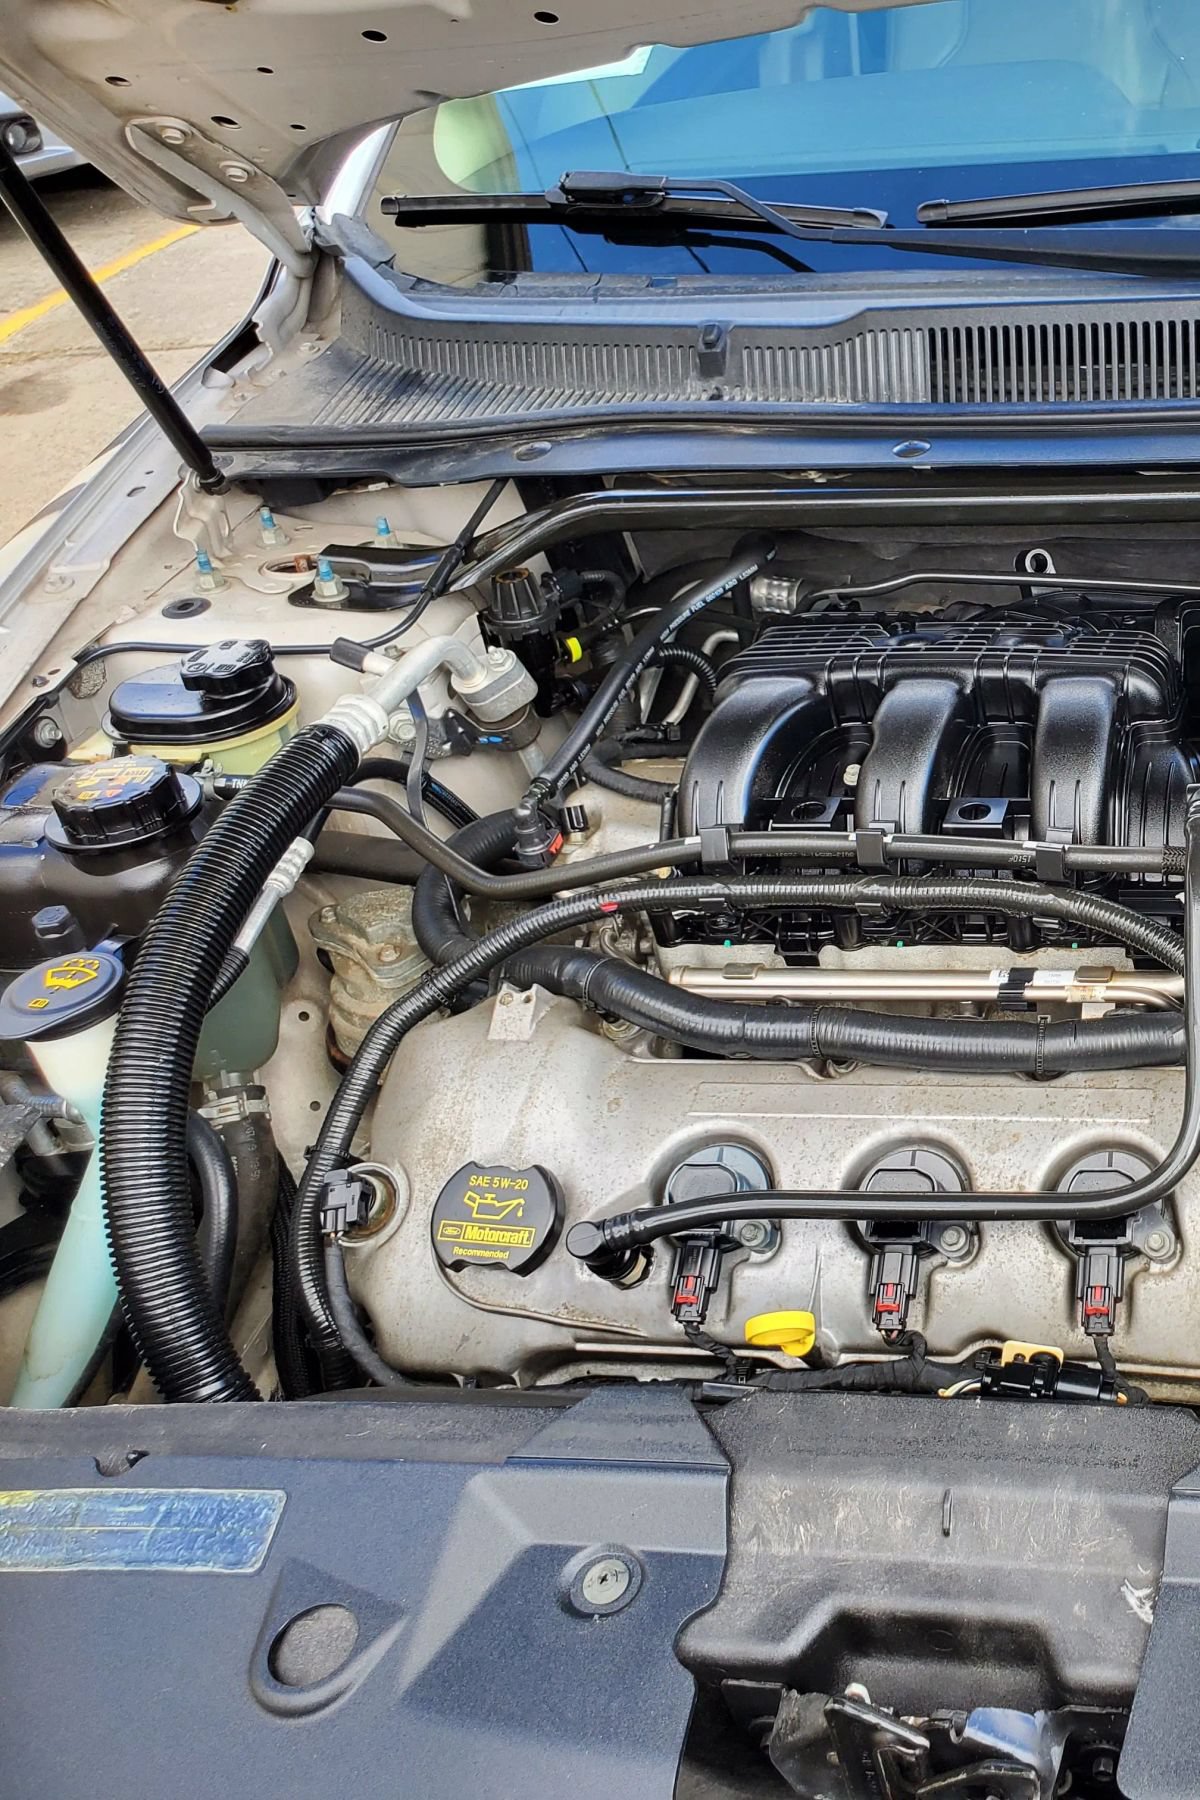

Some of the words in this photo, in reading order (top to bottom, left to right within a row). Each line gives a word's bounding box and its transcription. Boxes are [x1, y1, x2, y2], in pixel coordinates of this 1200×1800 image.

[469, 1175, 490, 1187] SAE
[492, 1177, 528, 1190] 5W-20
[464, 1225, 530, 1245] Motorcraft
[453, 1246, 509, 1259] Recommended
